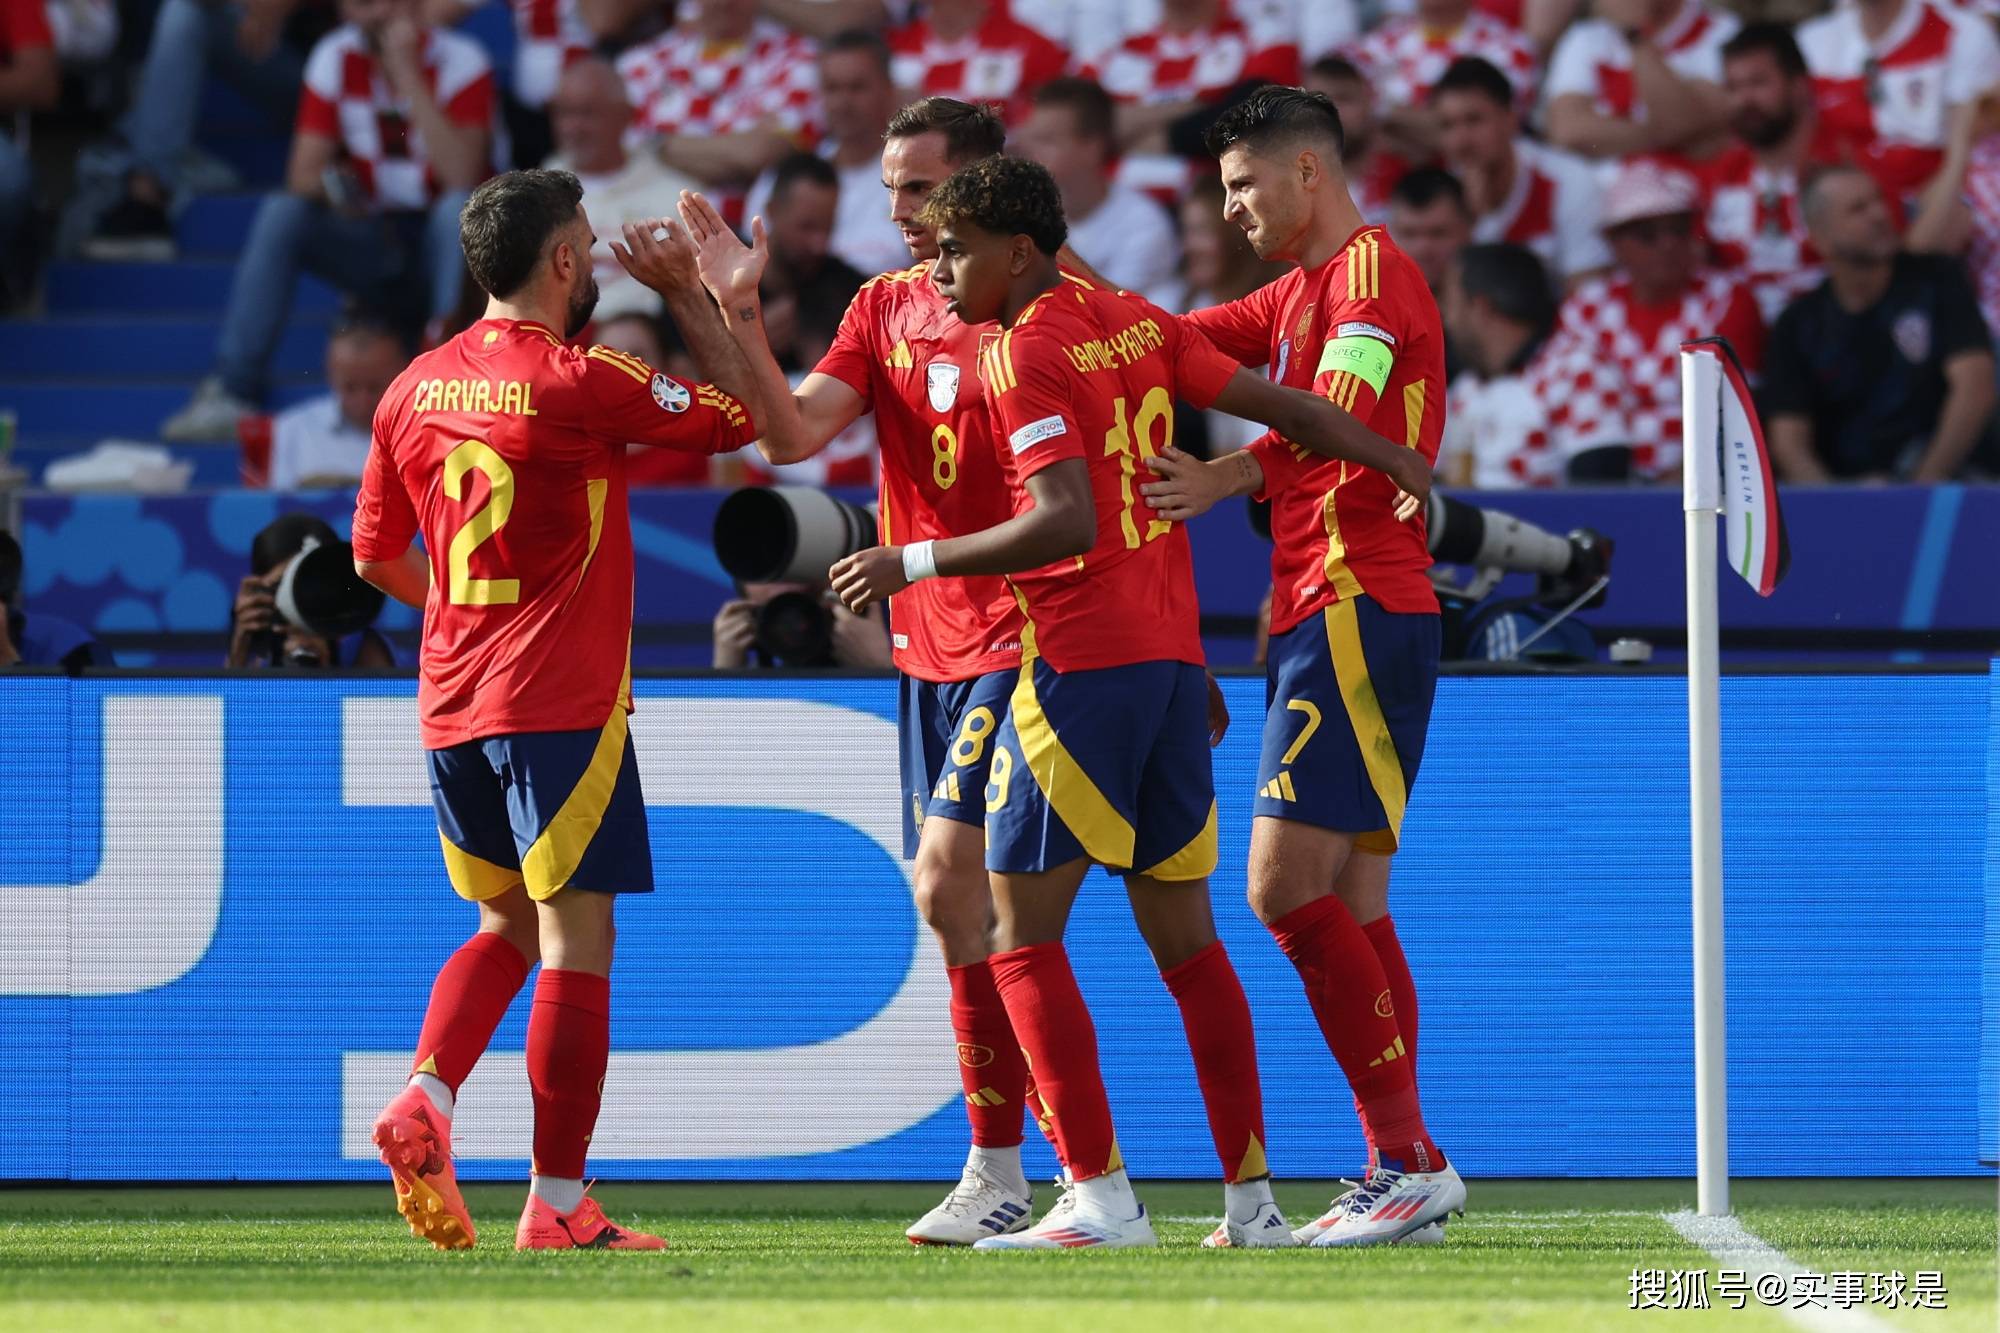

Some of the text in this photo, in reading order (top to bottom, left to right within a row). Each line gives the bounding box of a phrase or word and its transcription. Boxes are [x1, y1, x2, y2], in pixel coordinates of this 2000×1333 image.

[413, 378, 538, 415] CARVAJAL
[931, 423, 957, 490] 8
[1734, 442, 1753, 504] BERLIN
[443, 439, 520, 605] 2
[951, 706, 996, 767] 8
[1281, 699, 1322, 765] 7
[984, 746, 1013, 813] 9
